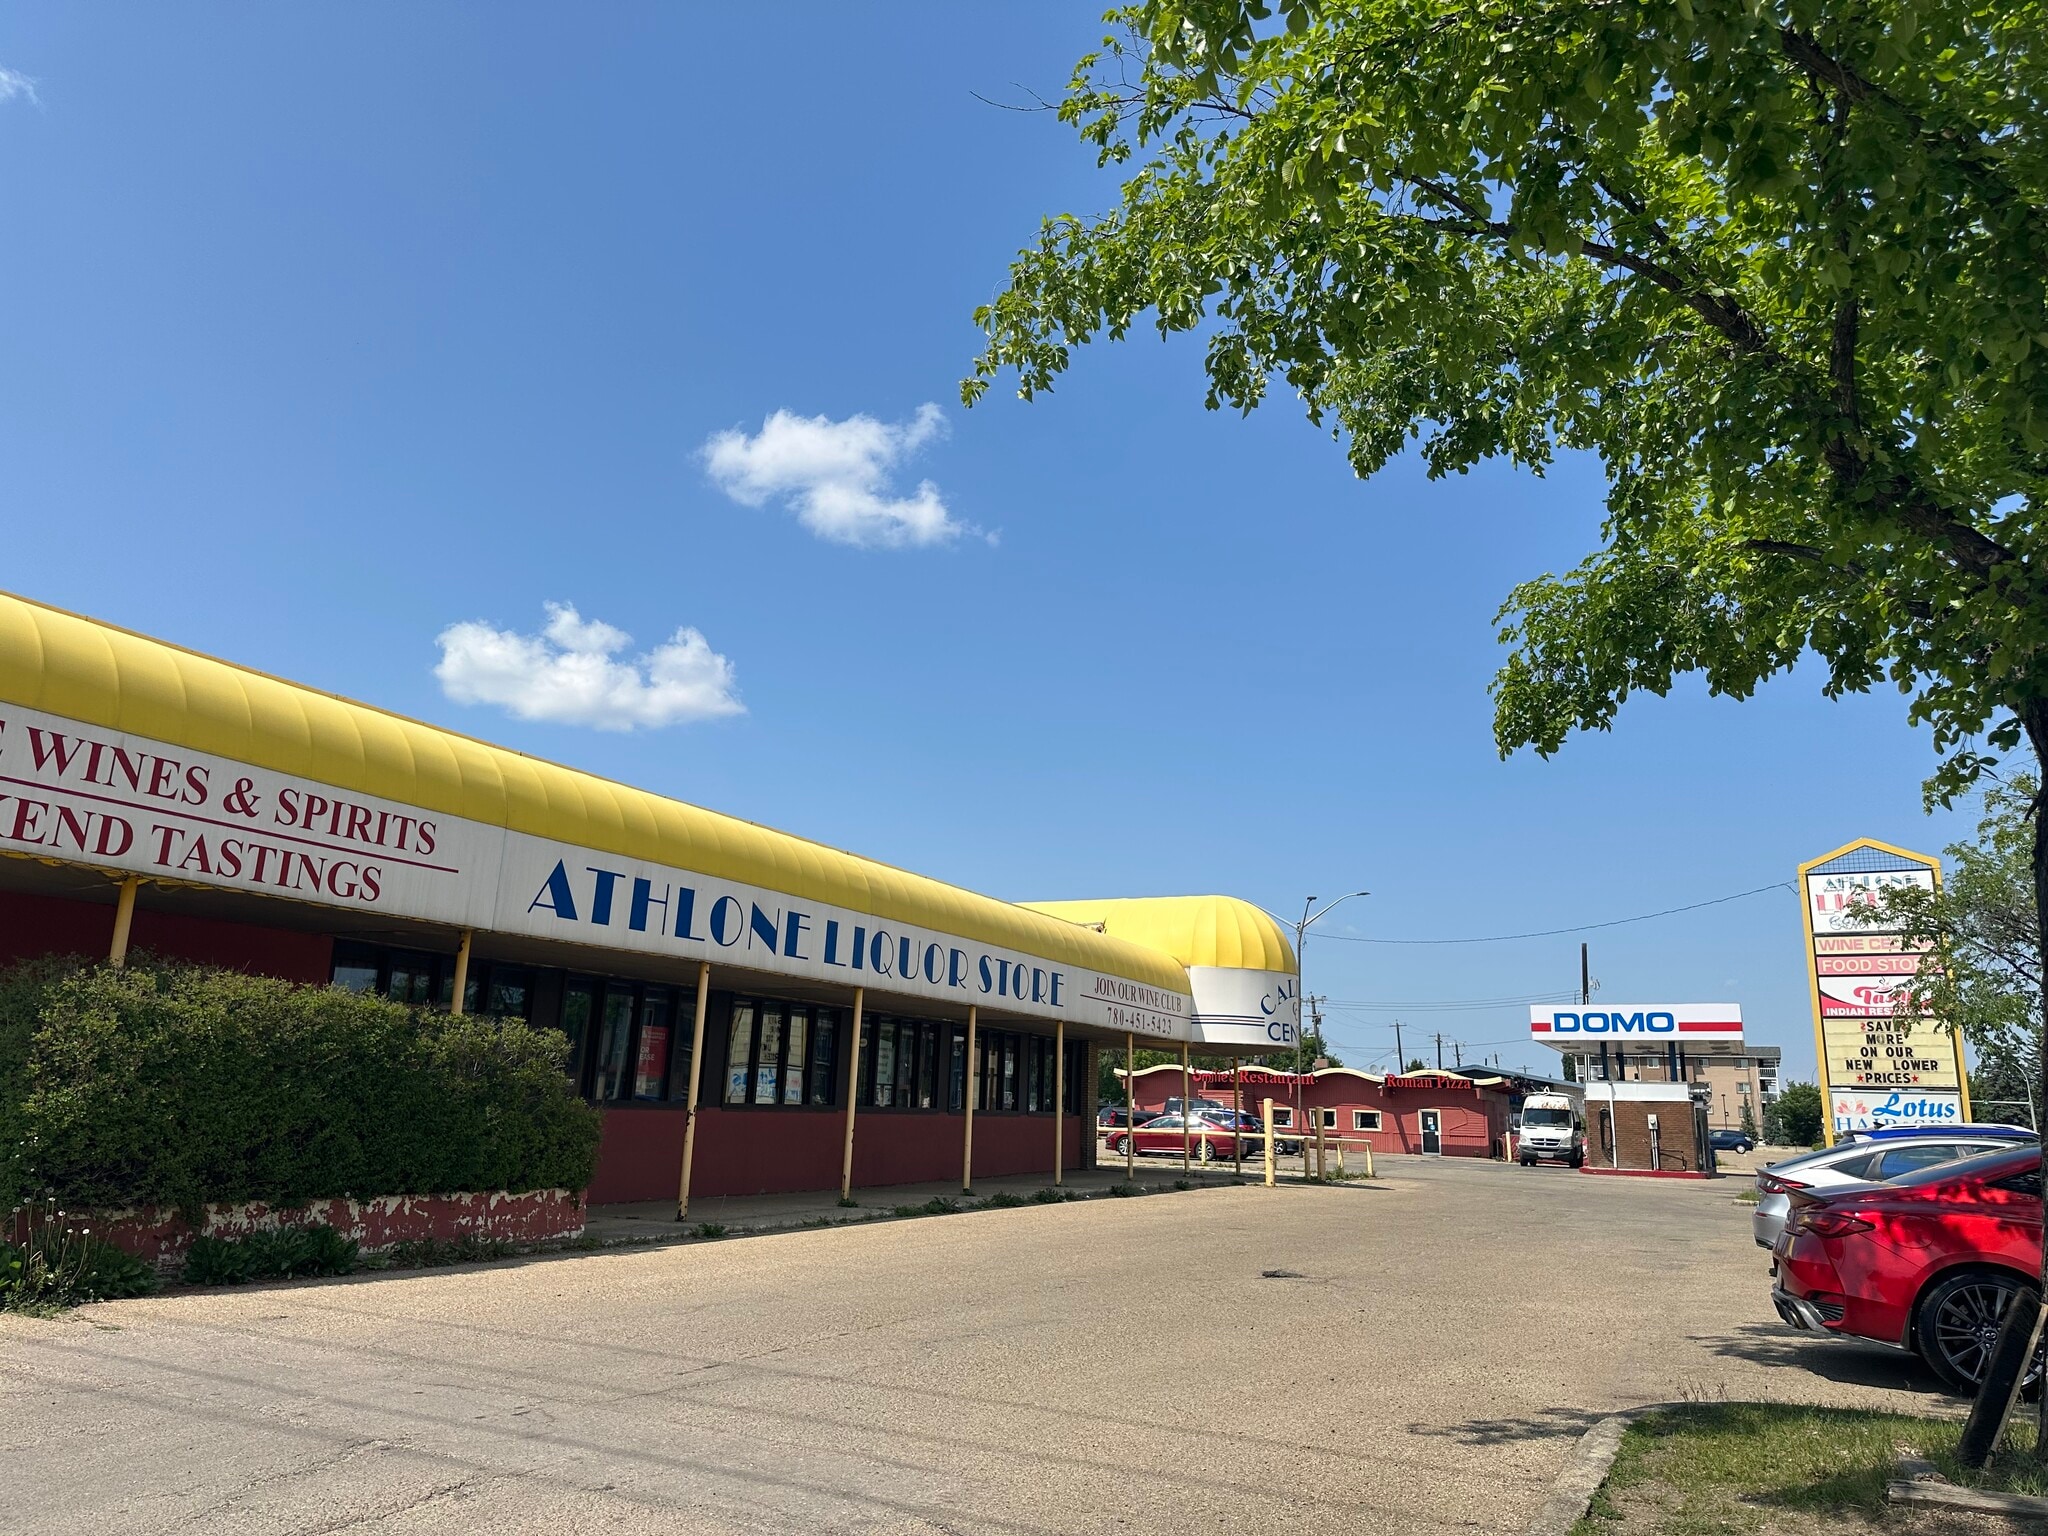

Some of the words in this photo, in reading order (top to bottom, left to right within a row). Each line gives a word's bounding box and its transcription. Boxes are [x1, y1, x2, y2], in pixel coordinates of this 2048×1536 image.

[26, 726, 211, 806] WINES
[223, 777, 261, 818] &
[274, 788, 437, 855] SPIRITS
[151, 824, 382, 902] TASTINGS
[527, 858, 811, 961] ATHLONE
[824, 919, 969, 989] LIQUOR
[977, 954, 1065, 1008] STORE
[1817, 938, 1864, 951] WINE
[1822, 959, 1872, 972] FOOD
[1094, 976, 1116, 996] JOIN
[1118, 984, 1137, 1002] OUR
[1137, 988, 1160, 1008] WINE
[1160, 993, 1182, 1013] CLUB
[1826, 1007, 1866, 1016] INDIAN
[1107, 1006, 1173, 1035] 780-451-5423
[1553, 1012, 1674, 1033] DOMO
[1866, 1034, 1903, 1045] MORE
[1860, 1047, 1877, 1057] ON
[1886, 1047, 1913, 1057] OUR
[1846, 1060, 1872, 1070] NEW
[1893, 1060, 1938, 1071] LOWER
[1240, 1070, 1315, 1085] Restaurant
[1386, 1074, 1433, 1088] Roman
[1437, 1076, 1471, 1090] Pizza
[1865, 1073, 1911, 1083] PRICES
[1872, 1093, 1955, 1118] Lotus
